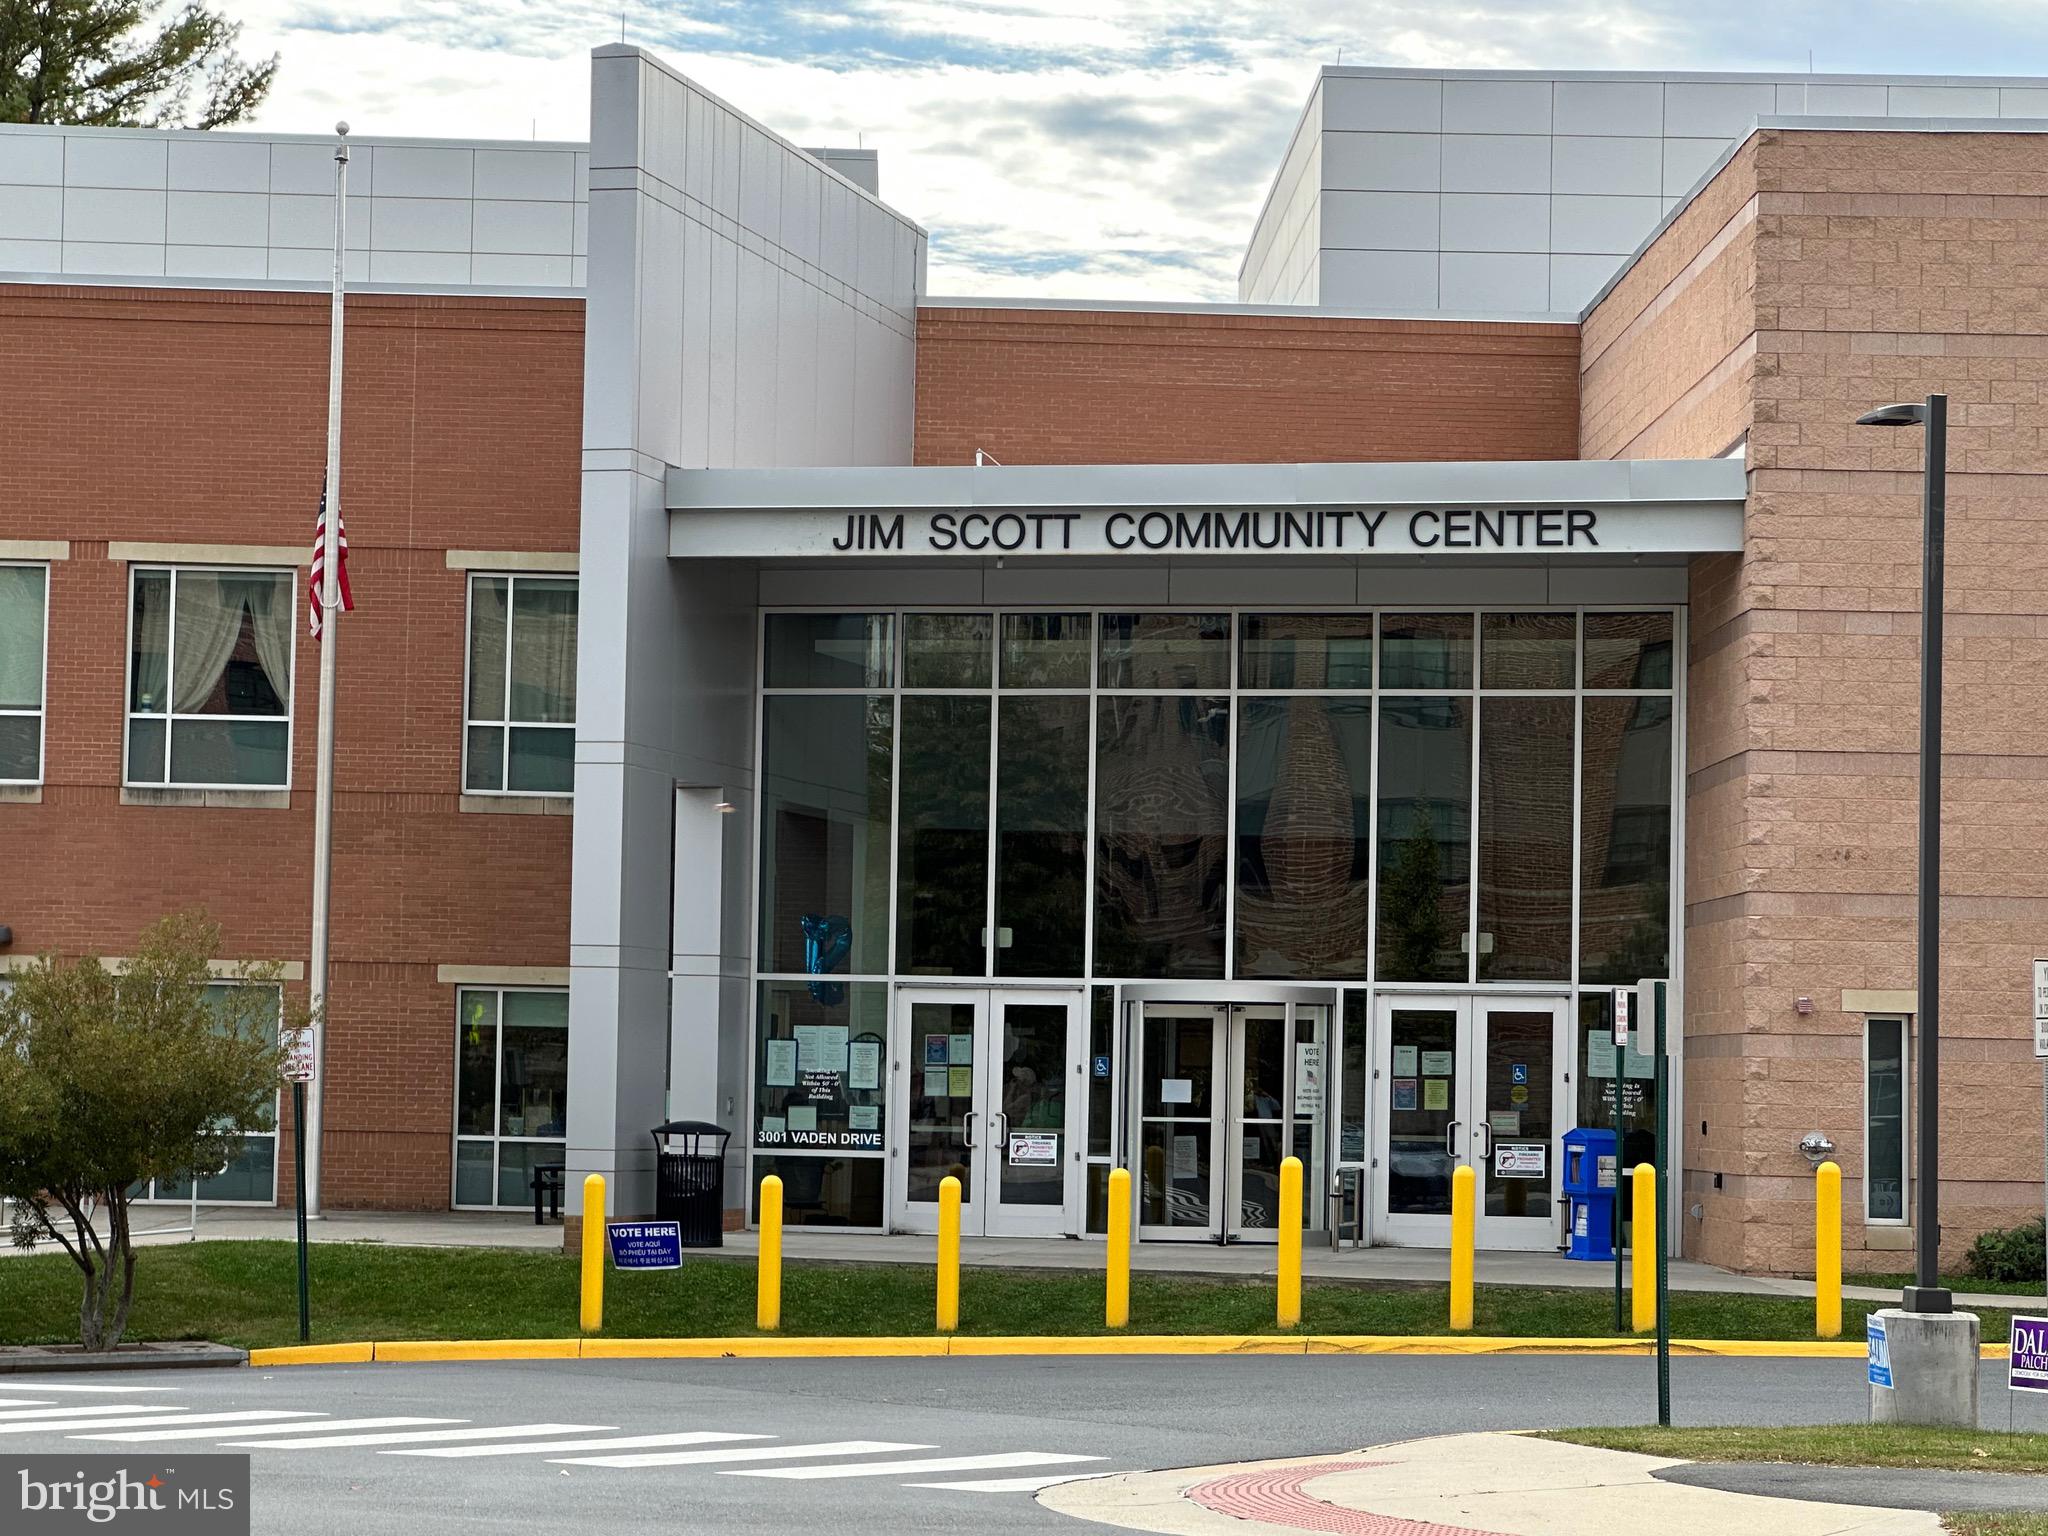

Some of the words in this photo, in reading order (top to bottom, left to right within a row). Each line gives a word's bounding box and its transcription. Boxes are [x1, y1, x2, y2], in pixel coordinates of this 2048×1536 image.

[832, 514, 904, 551] JIM
[929, 512, 1081, 550] SCOTT
[1105, 510, 1388, 549] COMMUNITY
[1409, 509, 1599, 548] CENTER
[1304, 1047, 1320, 1056] VOTE
[1304, 1058, 1320, 1067] HERE
[758, 1131, 787, 1143] 3001
[791, 1132, 837, 1144] VADEN
[841, 1133, 882, 1145] DRIVE
[612, 1228, 642, 1238] VOTE
[645, 1227, 677, 1237] HERE
[2020, 1354, 2048, 1370] PALCH
